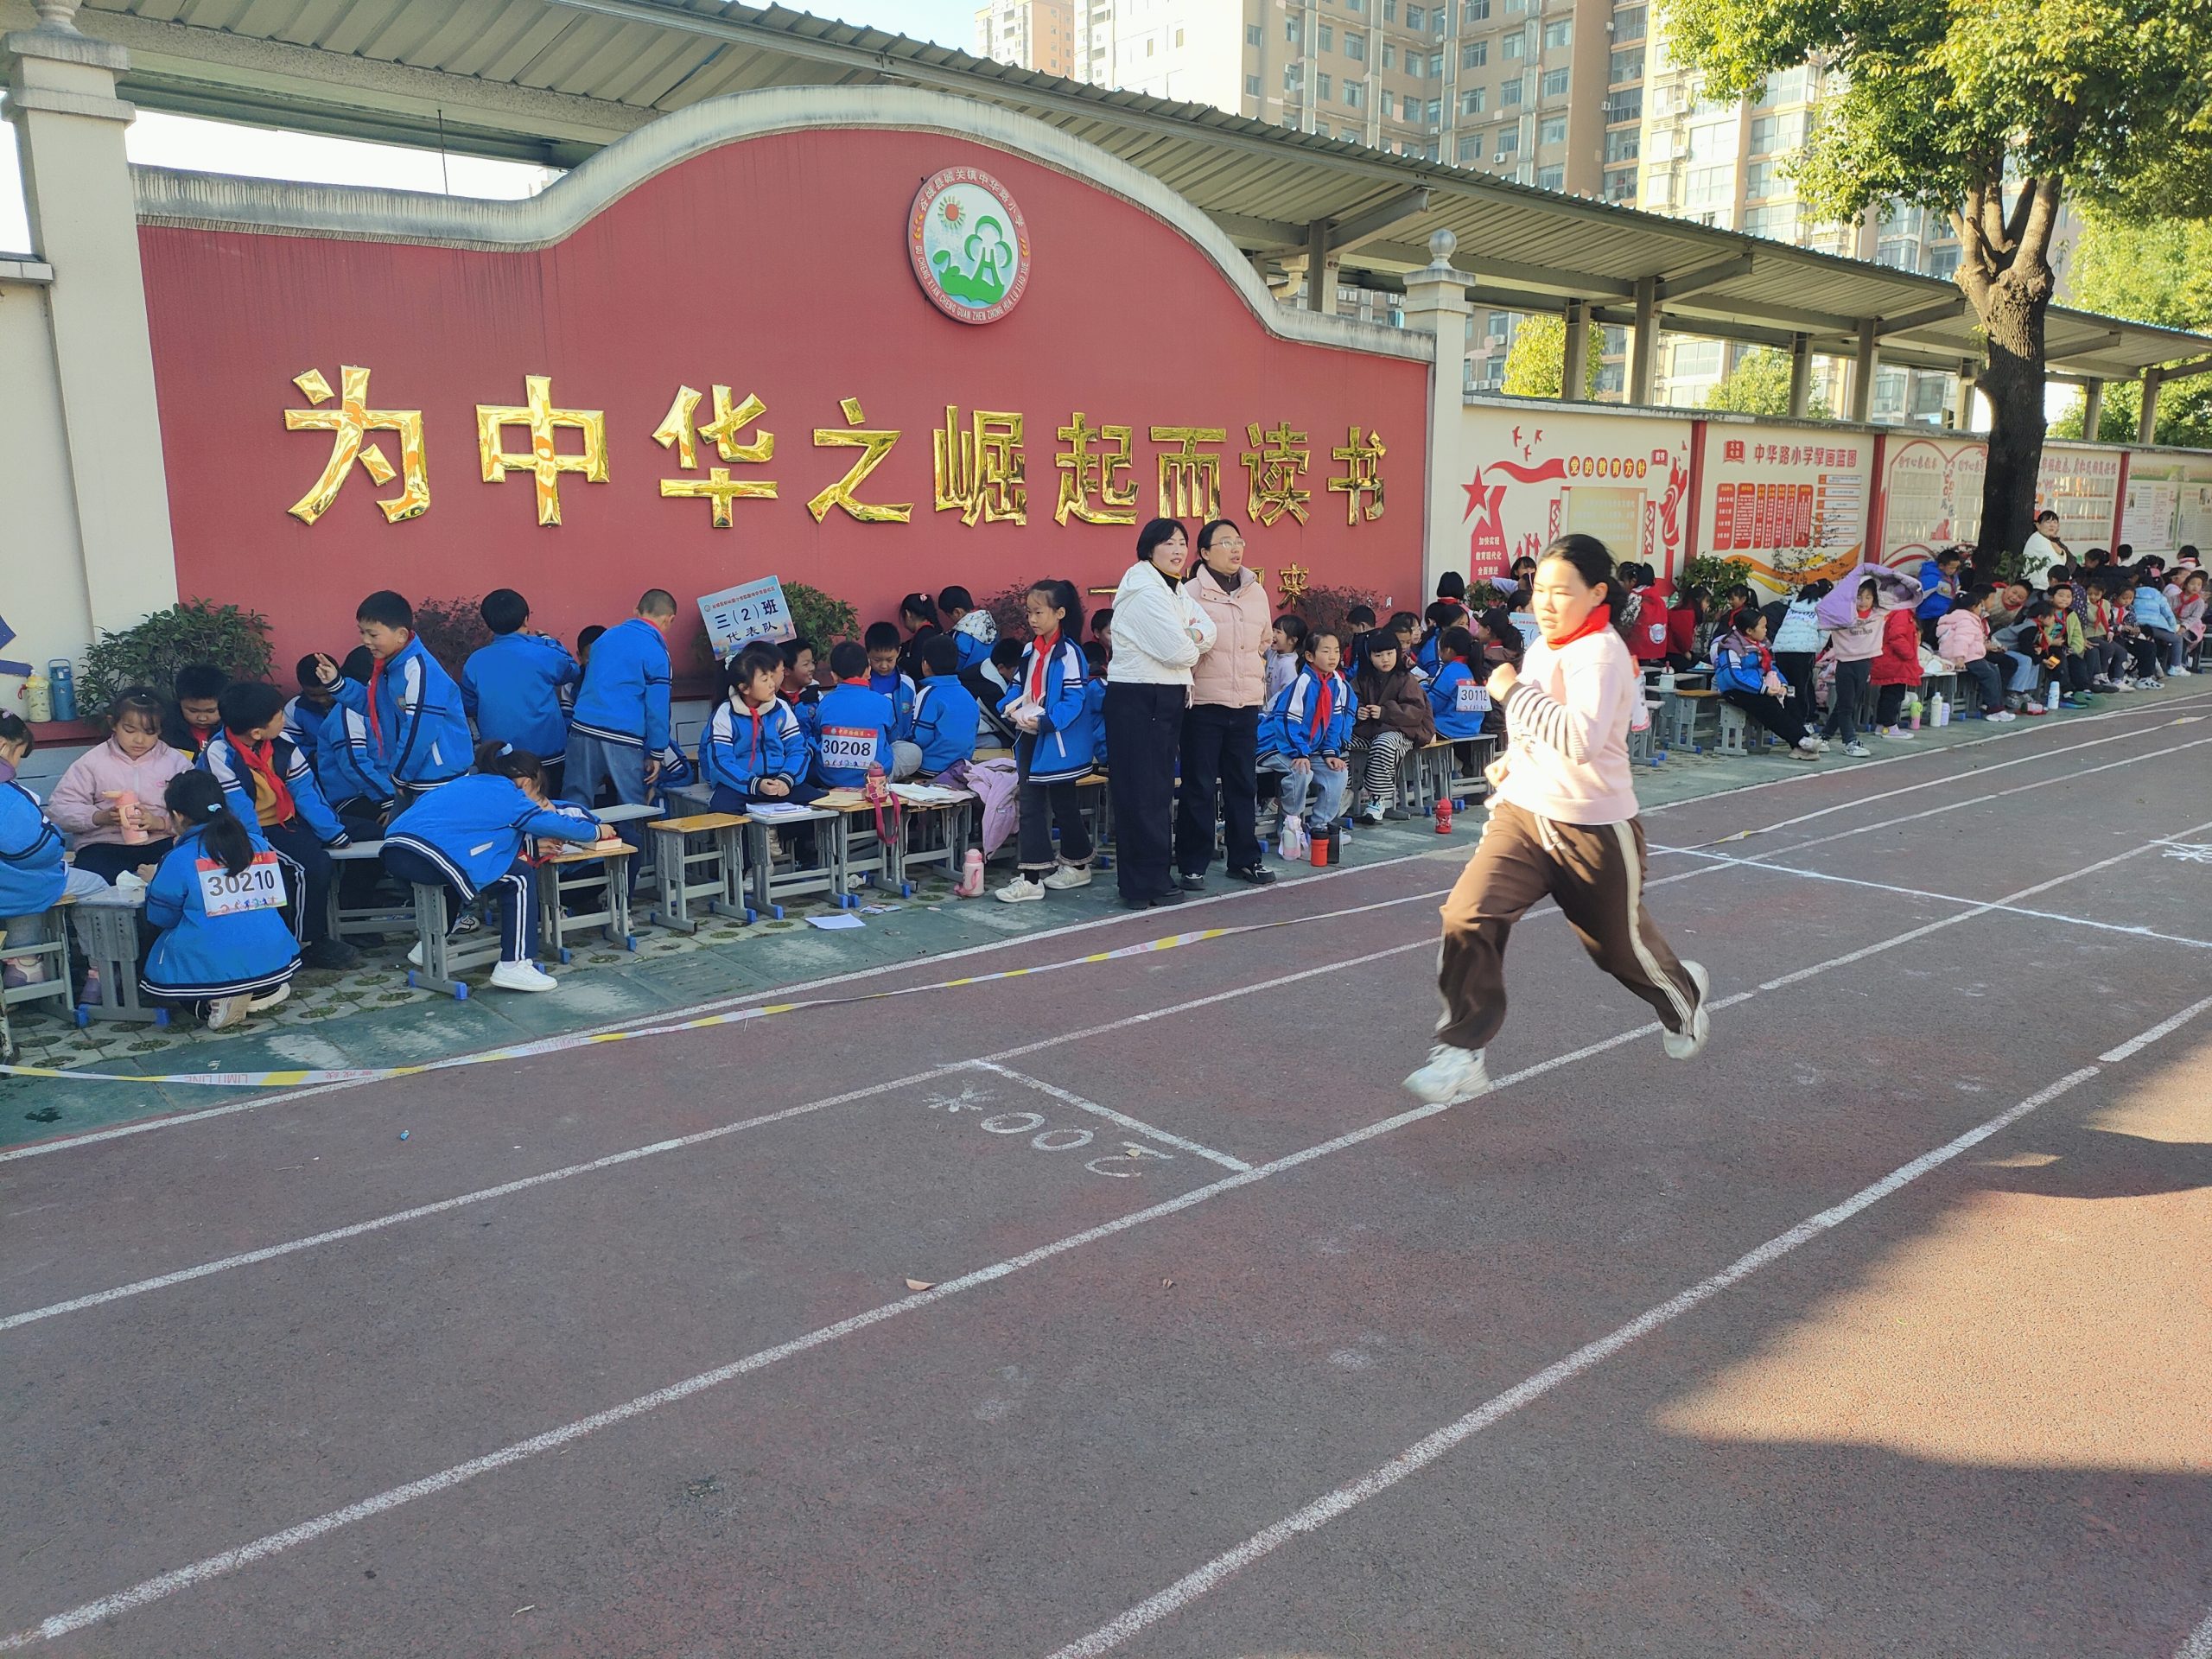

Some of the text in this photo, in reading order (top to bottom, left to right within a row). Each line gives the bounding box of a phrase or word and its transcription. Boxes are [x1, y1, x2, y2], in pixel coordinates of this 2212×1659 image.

[917, 257, 931, 280] CHENG
[1020, 262, 1030, 277] XUE
[926, 279, 941, 298] XIAN
[1016, 276, 1027, 294] XIAO
[1011, 289, 1019, 302] LU
[939, 295, 957, 314] CHENG
[988, 306, 1004, 319] ZHONG
[1002, 300, 1014, 312] HUA
[957, 308, 972, 320] GUAN
[972, 310, 987, 321] ZHEN
[283, 364, 1387, 527] 为中华之崛起而读书
[1570, 458, 1646, 476] 党的教育方针
[726, 621, 778, 644] 代表队
[1461, 690, 1487, 702] 30112
[823, 739, 871, 756] 30208
[207, 869, 275, 897] 30210
